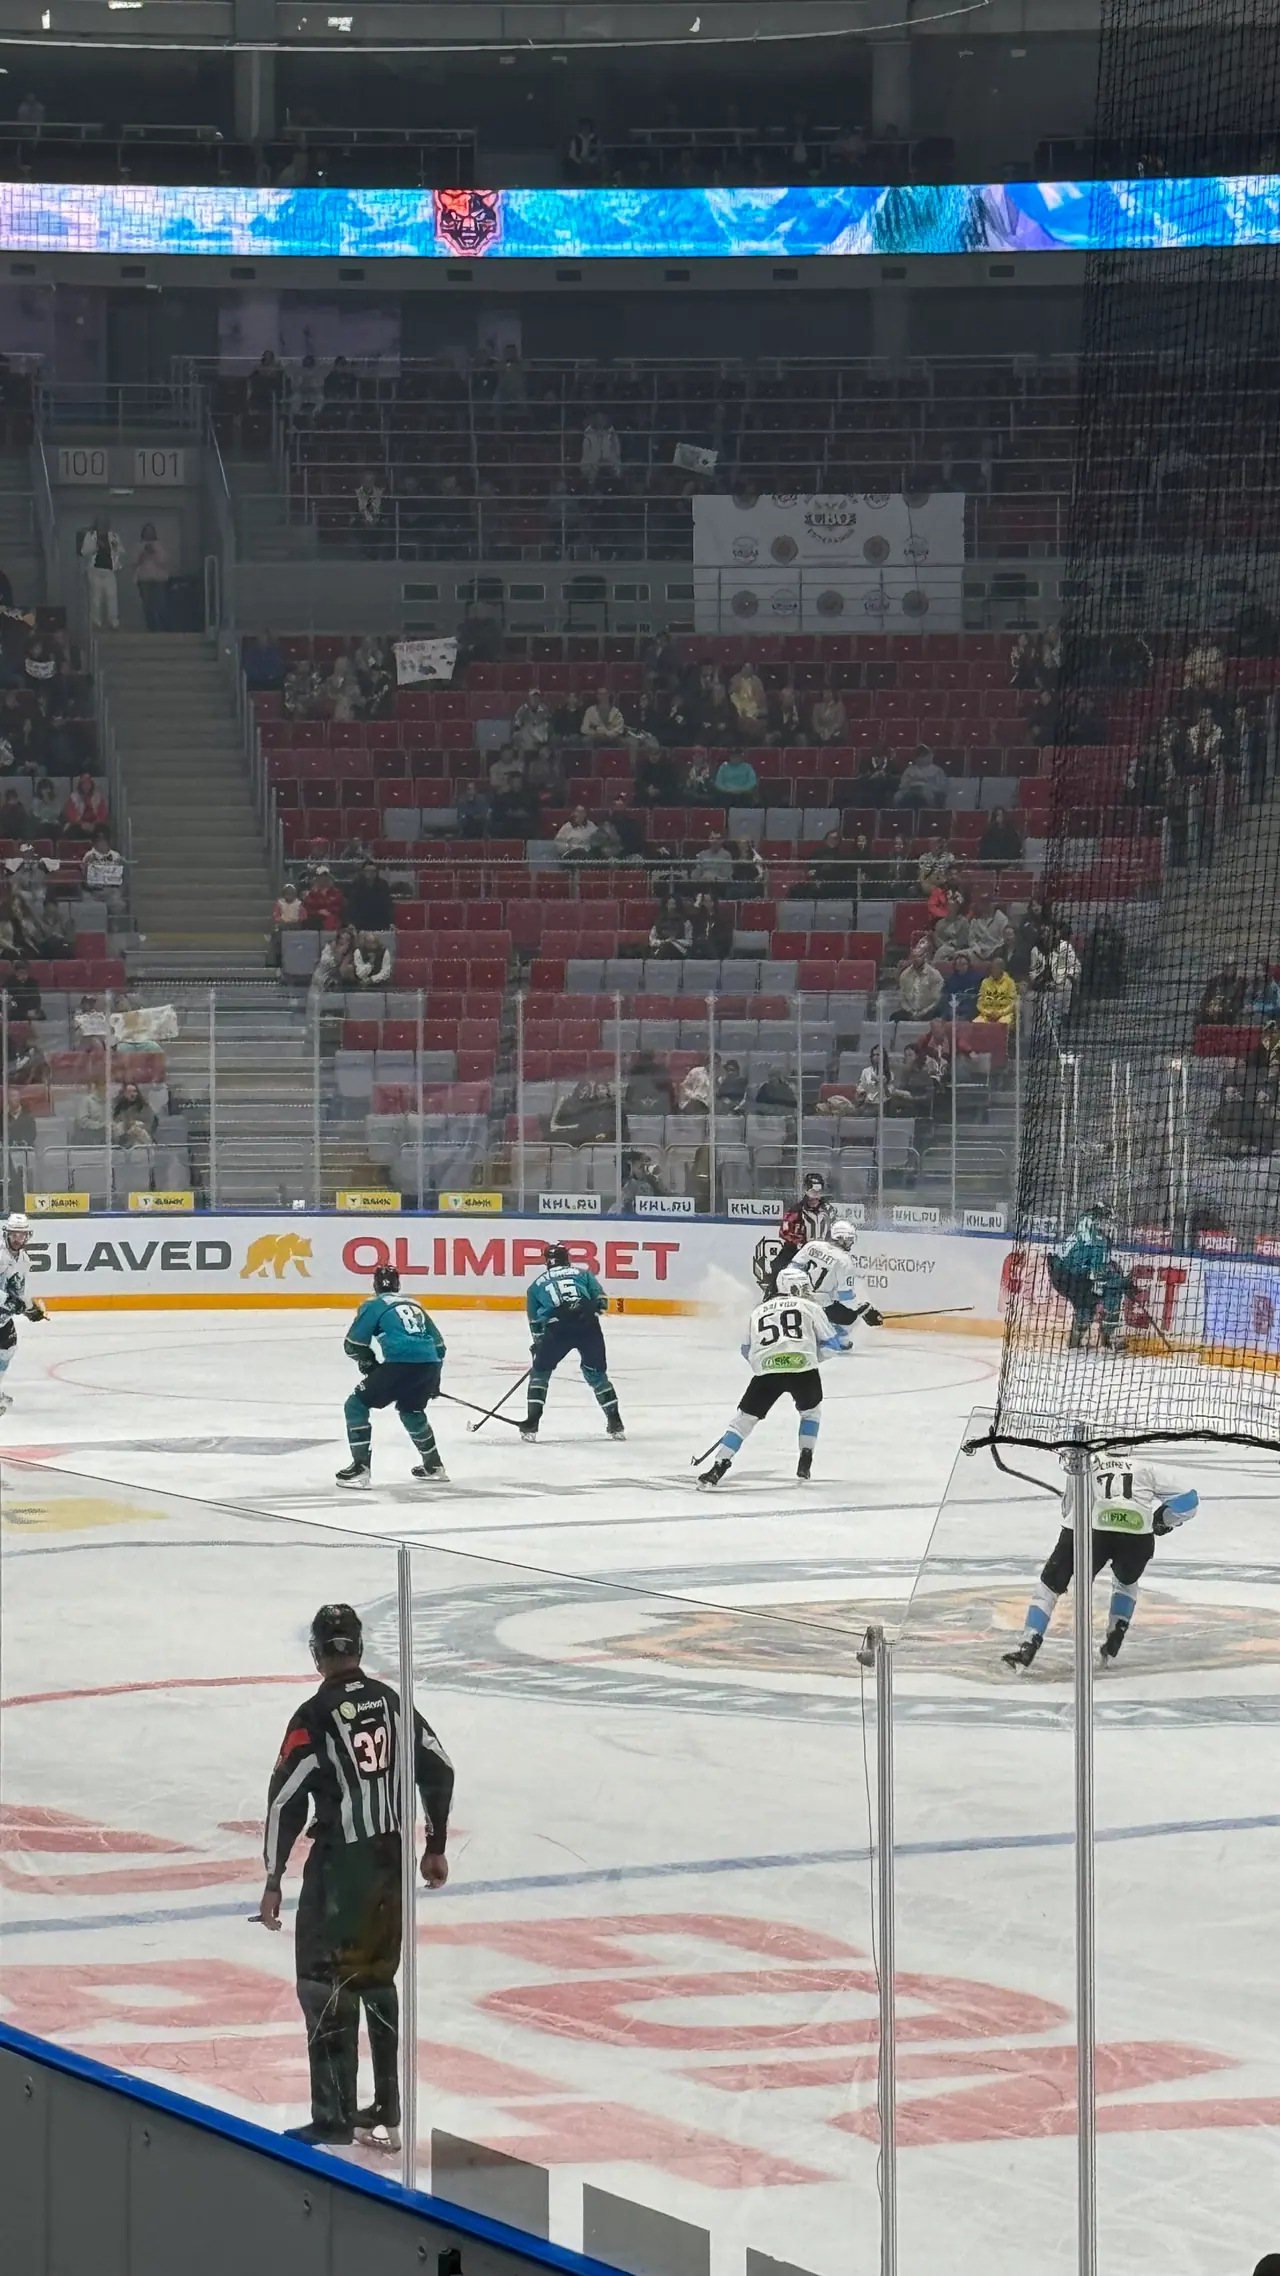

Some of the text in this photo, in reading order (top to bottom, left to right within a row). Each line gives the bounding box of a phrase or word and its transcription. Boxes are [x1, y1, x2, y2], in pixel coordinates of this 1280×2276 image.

[62, 451, 105, 476] 100
[138, 452, 179, 477] 101
[341, 1236, 680, 1281] OLIMPBET
[545, 1279, 581, 1307] 15
[757, 1309, 803, 1347] 58
[1096, 1472, 1133, 1499] 71
[353, 1726, 388, 1773] 32
